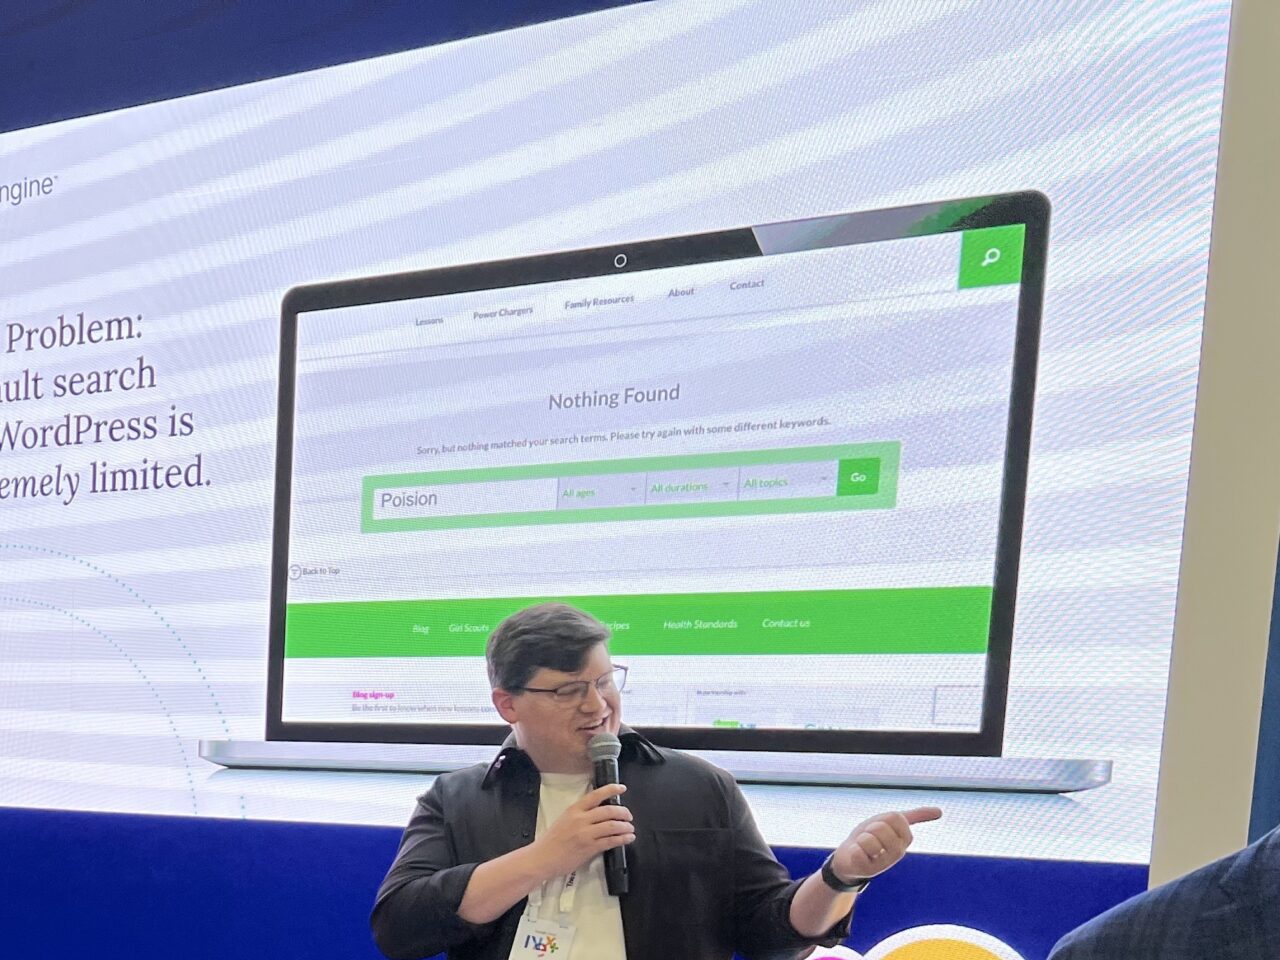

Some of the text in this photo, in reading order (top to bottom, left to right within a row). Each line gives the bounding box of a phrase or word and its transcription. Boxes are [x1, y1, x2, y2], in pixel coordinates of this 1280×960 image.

[730, 279, 765, 291] Contact
[669, 287, 695, 298] About
[565, 294, 634, 311] Family Resources
[6, 312, 143, 354] Problem:
[53, 356, 157, 398] search
[549, 383, 681, 411] Nothing Found
[168, 404, 194, 438] is
[442, 444, 456, 453] but
[457, 441, 489, 453] nothing
[491, 439, 527, 449] matched
[528, 438, 549, 449] your
[549, 435, 578, 445] search
[580, 433, 608, 443] terms.
[610, 431, 639, 441] Please
[641, 430, 656, 440] try
[657, 427, 682, 439] again
[683, 425, 705, 436] with
[706, 424, 732, 434] some
[733, 420, 777, 432] different
[779, 416, 831, 430] keywords.
[89, 453, 211, 494] limited.
[850, 472, 867, 482] Go
[651, 482, 709, 493] All durations
[744, 477, 788, 489] All topics
[380, 487, 438, 510] Poision
[563, 489, 574, 497] All
[303, 567, 318, 575] Back
[663, 618, 738, 630] Health Standards
[762, 617, 811, 629] Contact us
